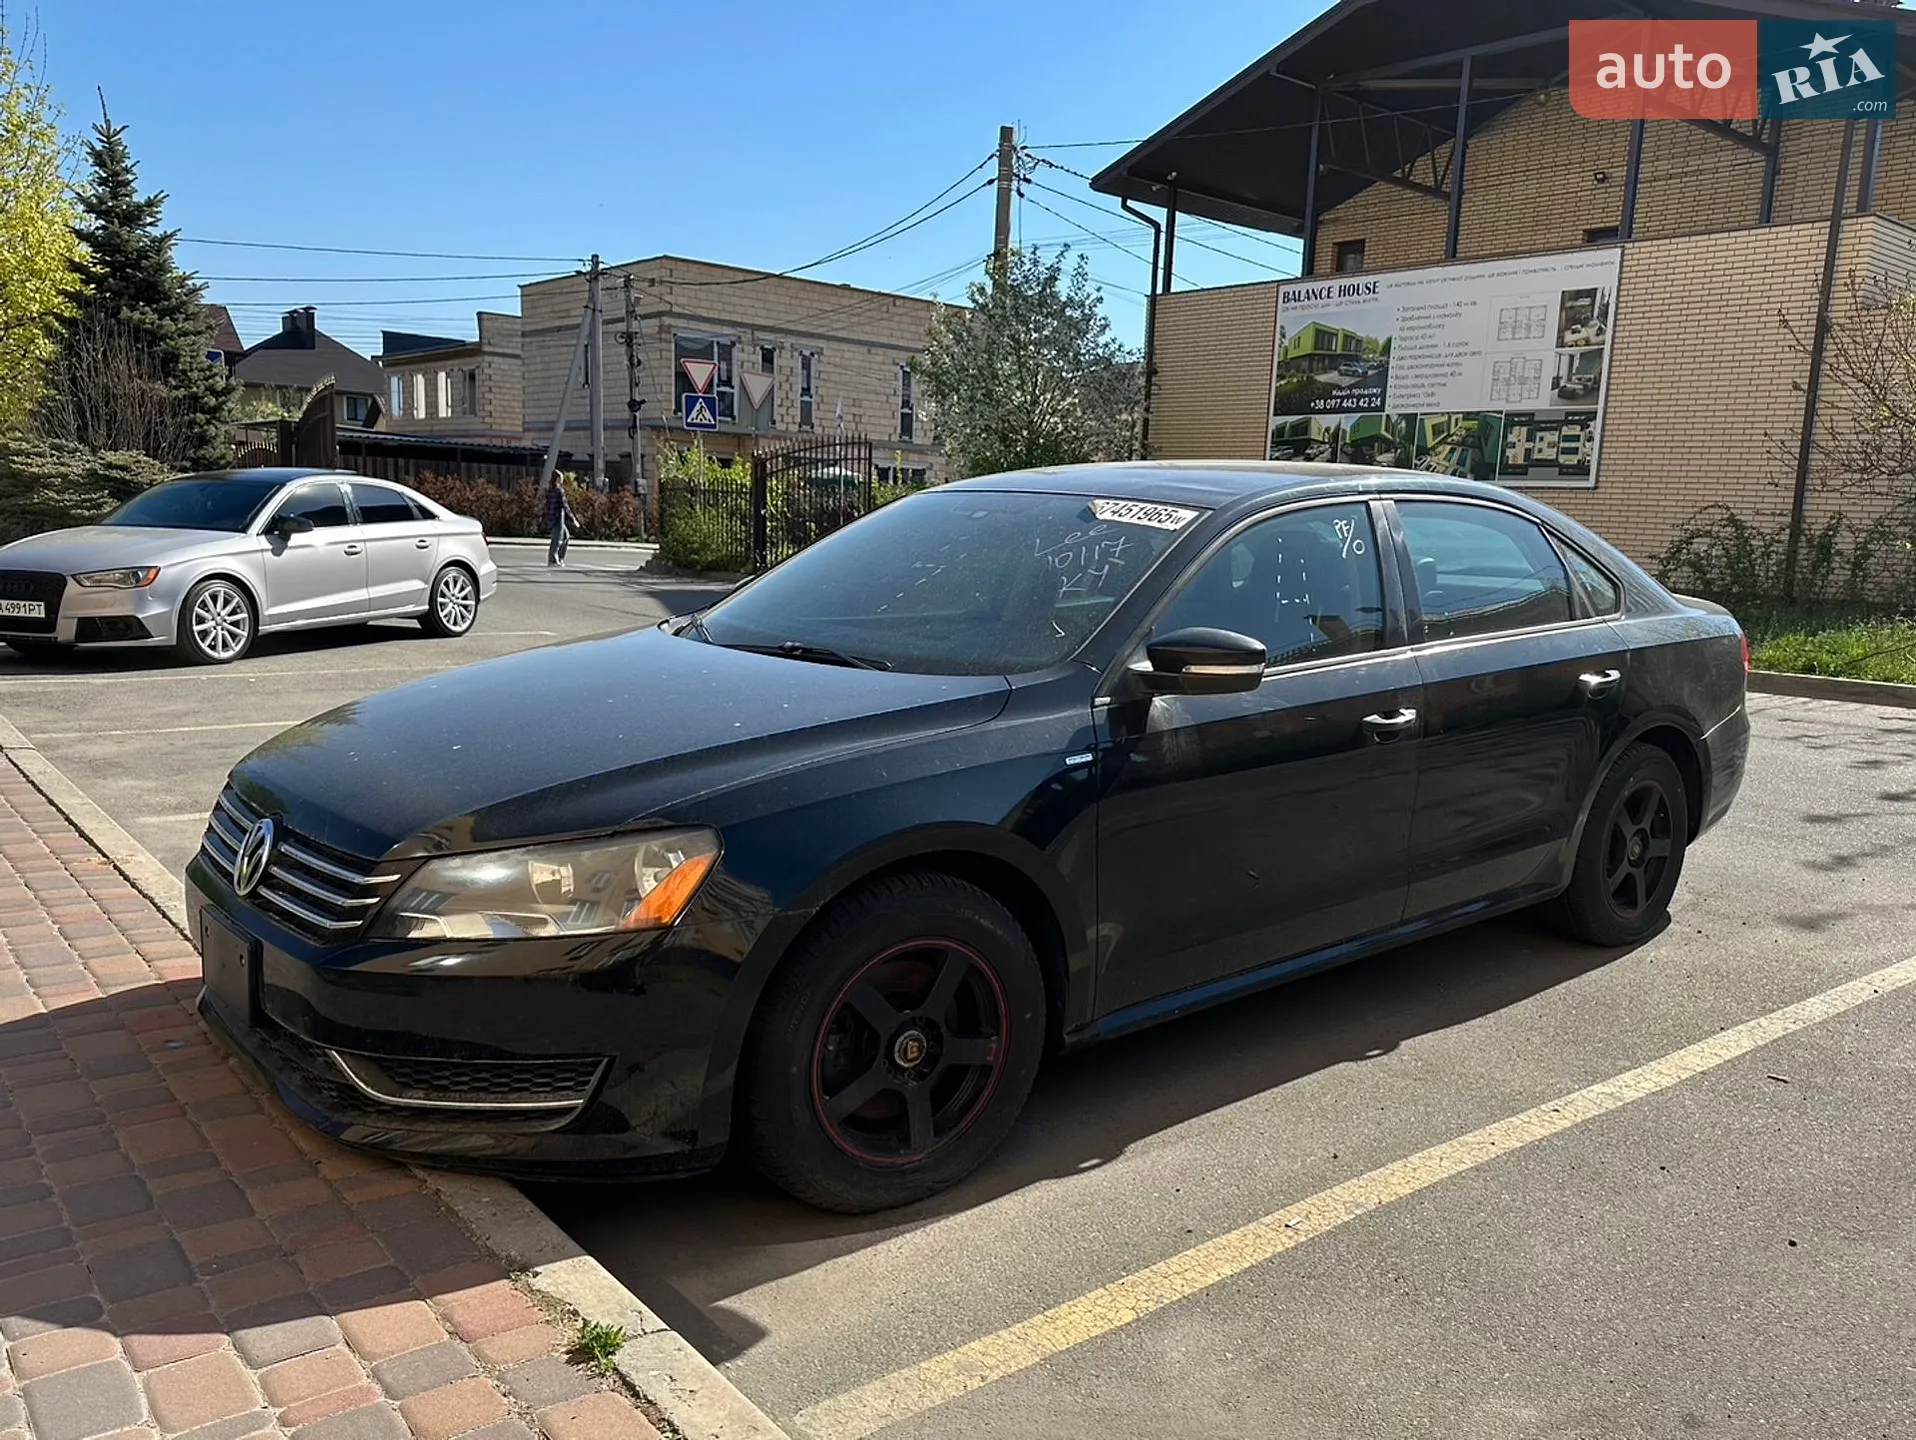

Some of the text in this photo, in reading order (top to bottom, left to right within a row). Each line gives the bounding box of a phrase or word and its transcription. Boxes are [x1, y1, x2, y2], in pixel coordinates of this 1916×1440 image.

[1282, 281, 1380, 305] BALANCE HOUSE
[1325, 398, 1341, 409] 097
[1341, 398, 1357, 408] 443
[1359, 397, 1369, 407] 42
[1370, 397, 1382, 407] 24
